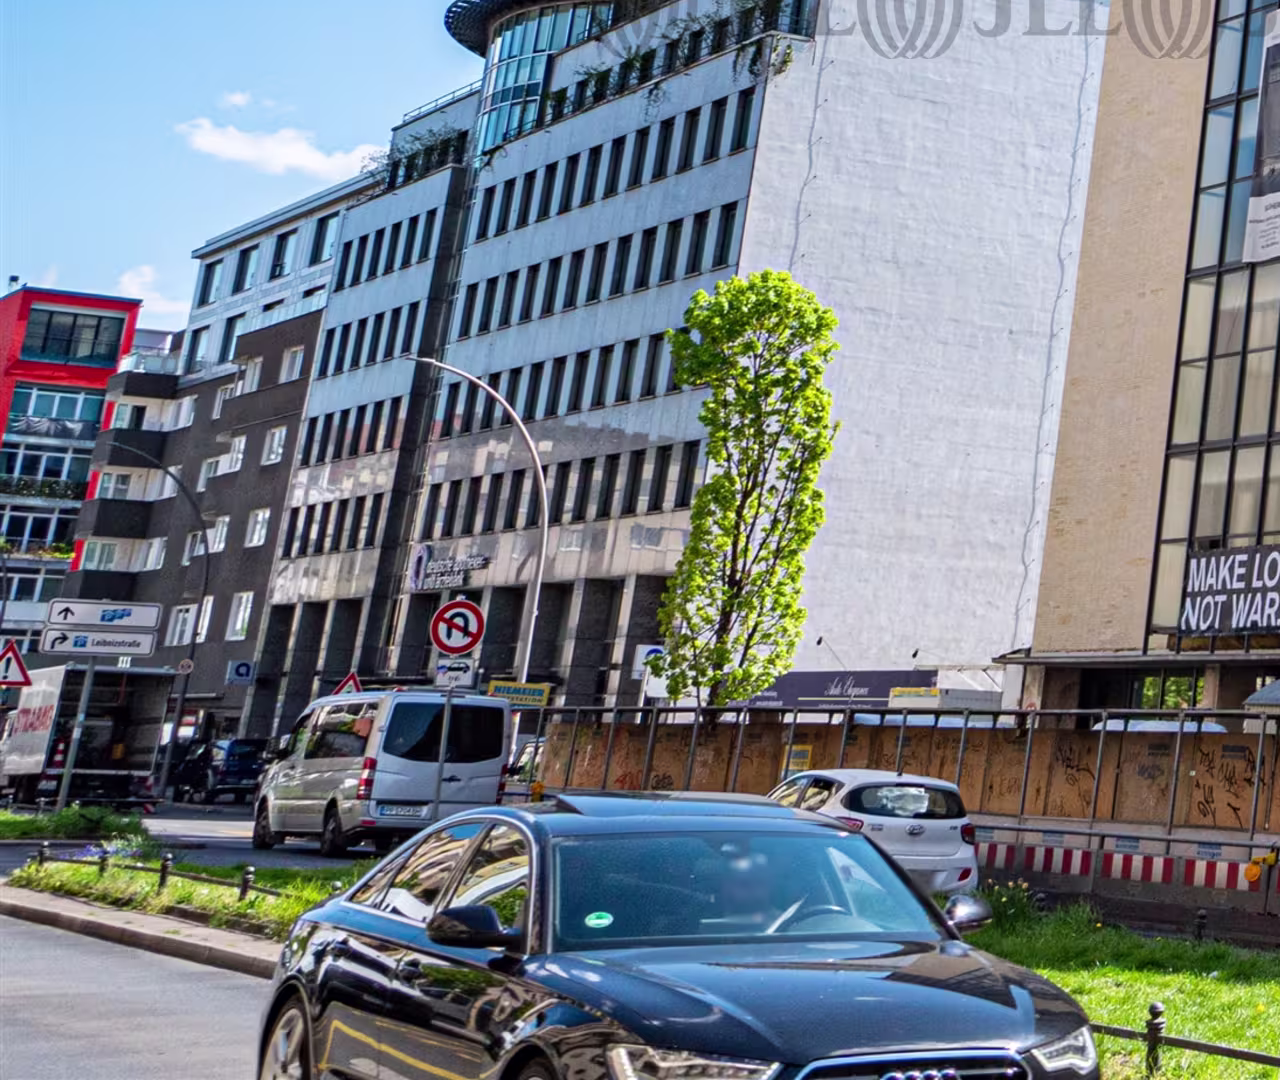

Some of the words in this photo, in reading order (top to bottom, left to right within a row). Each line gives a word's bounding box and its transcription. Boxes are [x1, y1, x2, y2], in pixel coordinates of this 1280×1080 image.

[1187, 553, 1248, 593] MAKE
[1180, 594, 1227, 631] NOT
[91, 638, 142, 648] Leibnizstraße
